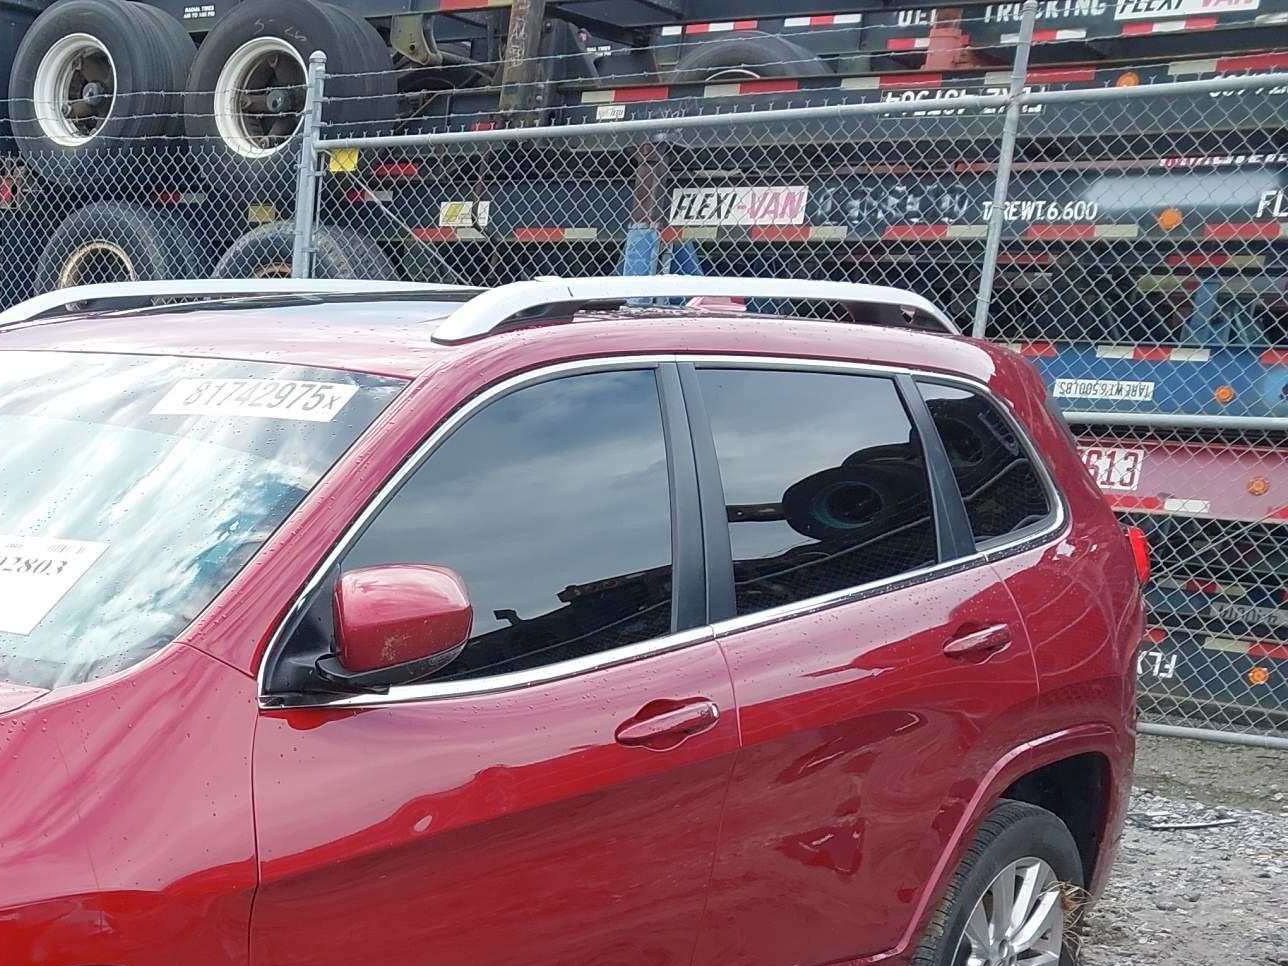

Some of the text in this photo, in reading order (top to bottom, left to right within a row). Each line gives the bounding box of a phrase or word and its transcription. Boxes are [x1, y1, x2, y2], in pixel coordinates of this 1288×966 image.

[898, 10, 937, 27] OE
[672, 190, 807, 221] FLEXI-VAN
[1078, 449, 1138, 488] 613
